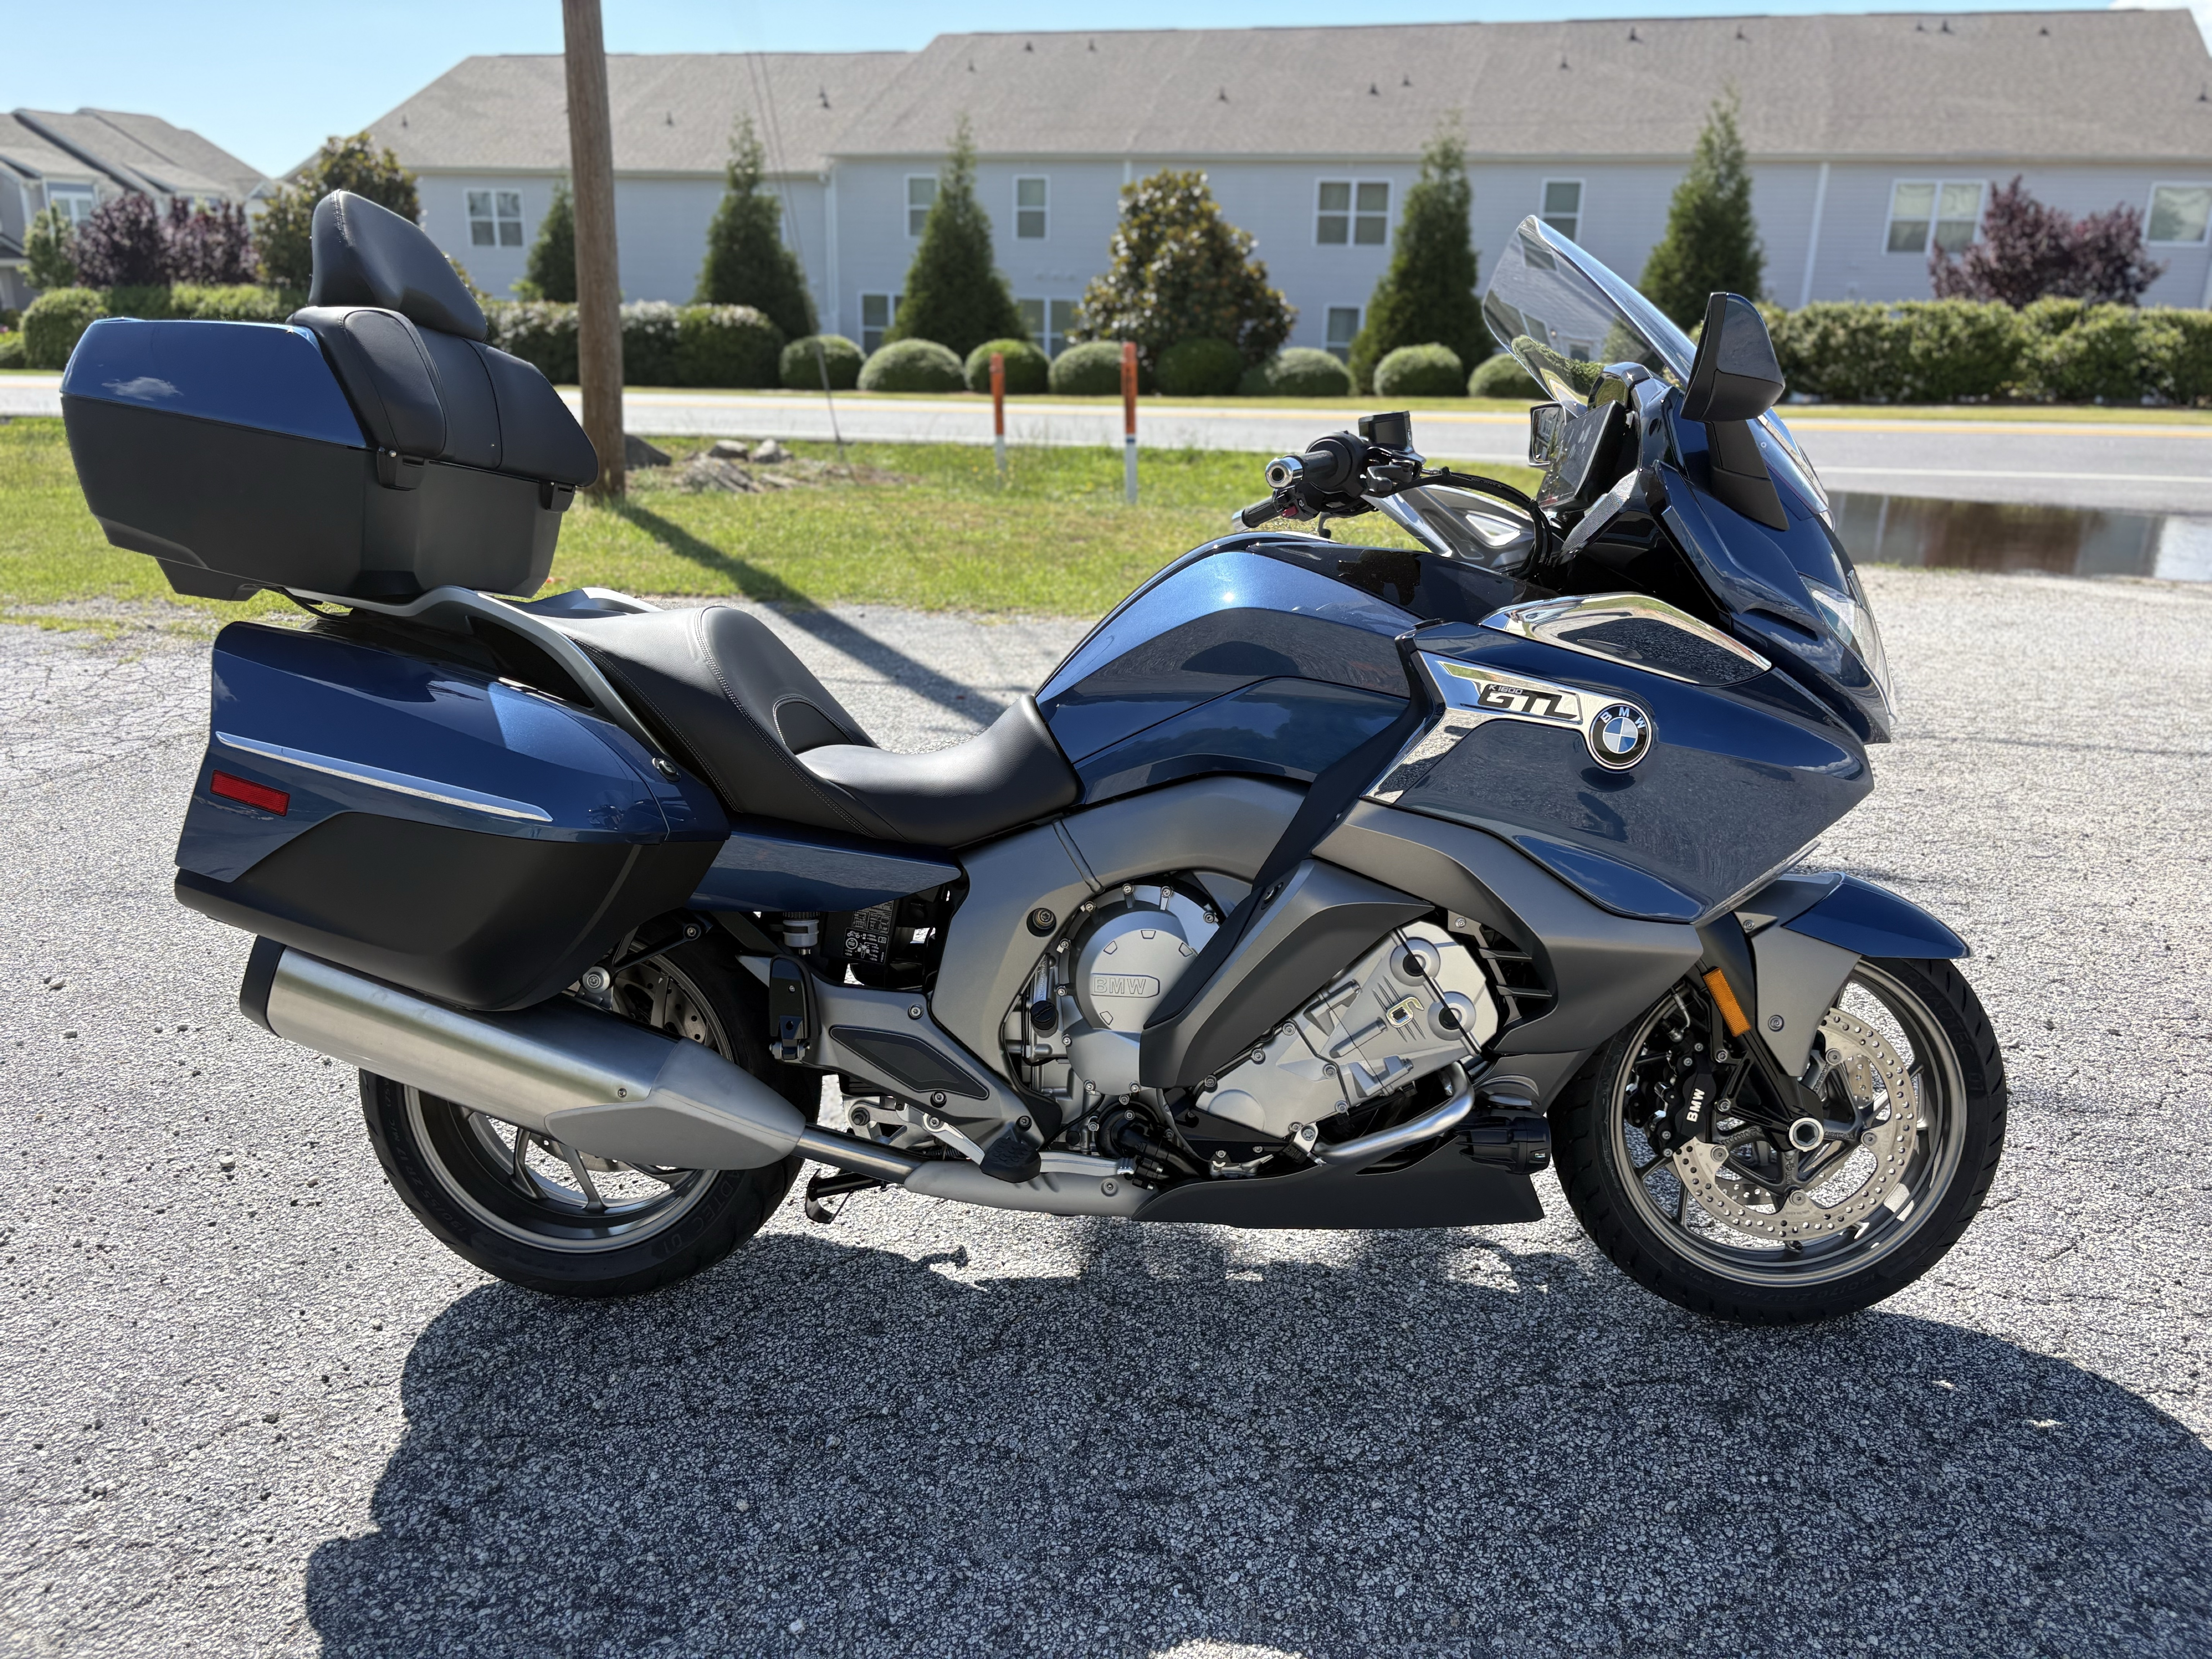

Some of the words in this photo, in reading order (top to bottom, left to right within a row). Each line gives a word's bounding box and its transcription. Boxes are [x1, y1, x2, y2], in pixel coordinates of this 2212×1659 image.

[1478, 684, 1578, 719] GTL
[1498, 686, 1523, 695] 1600
[1600, 707, 1645, 729] BMW
[1094, 976, 1146, 994] BMW
[1686, 1088, 1705, 1122] BMW
[691, 1170, 741, 1233] ADTEC
